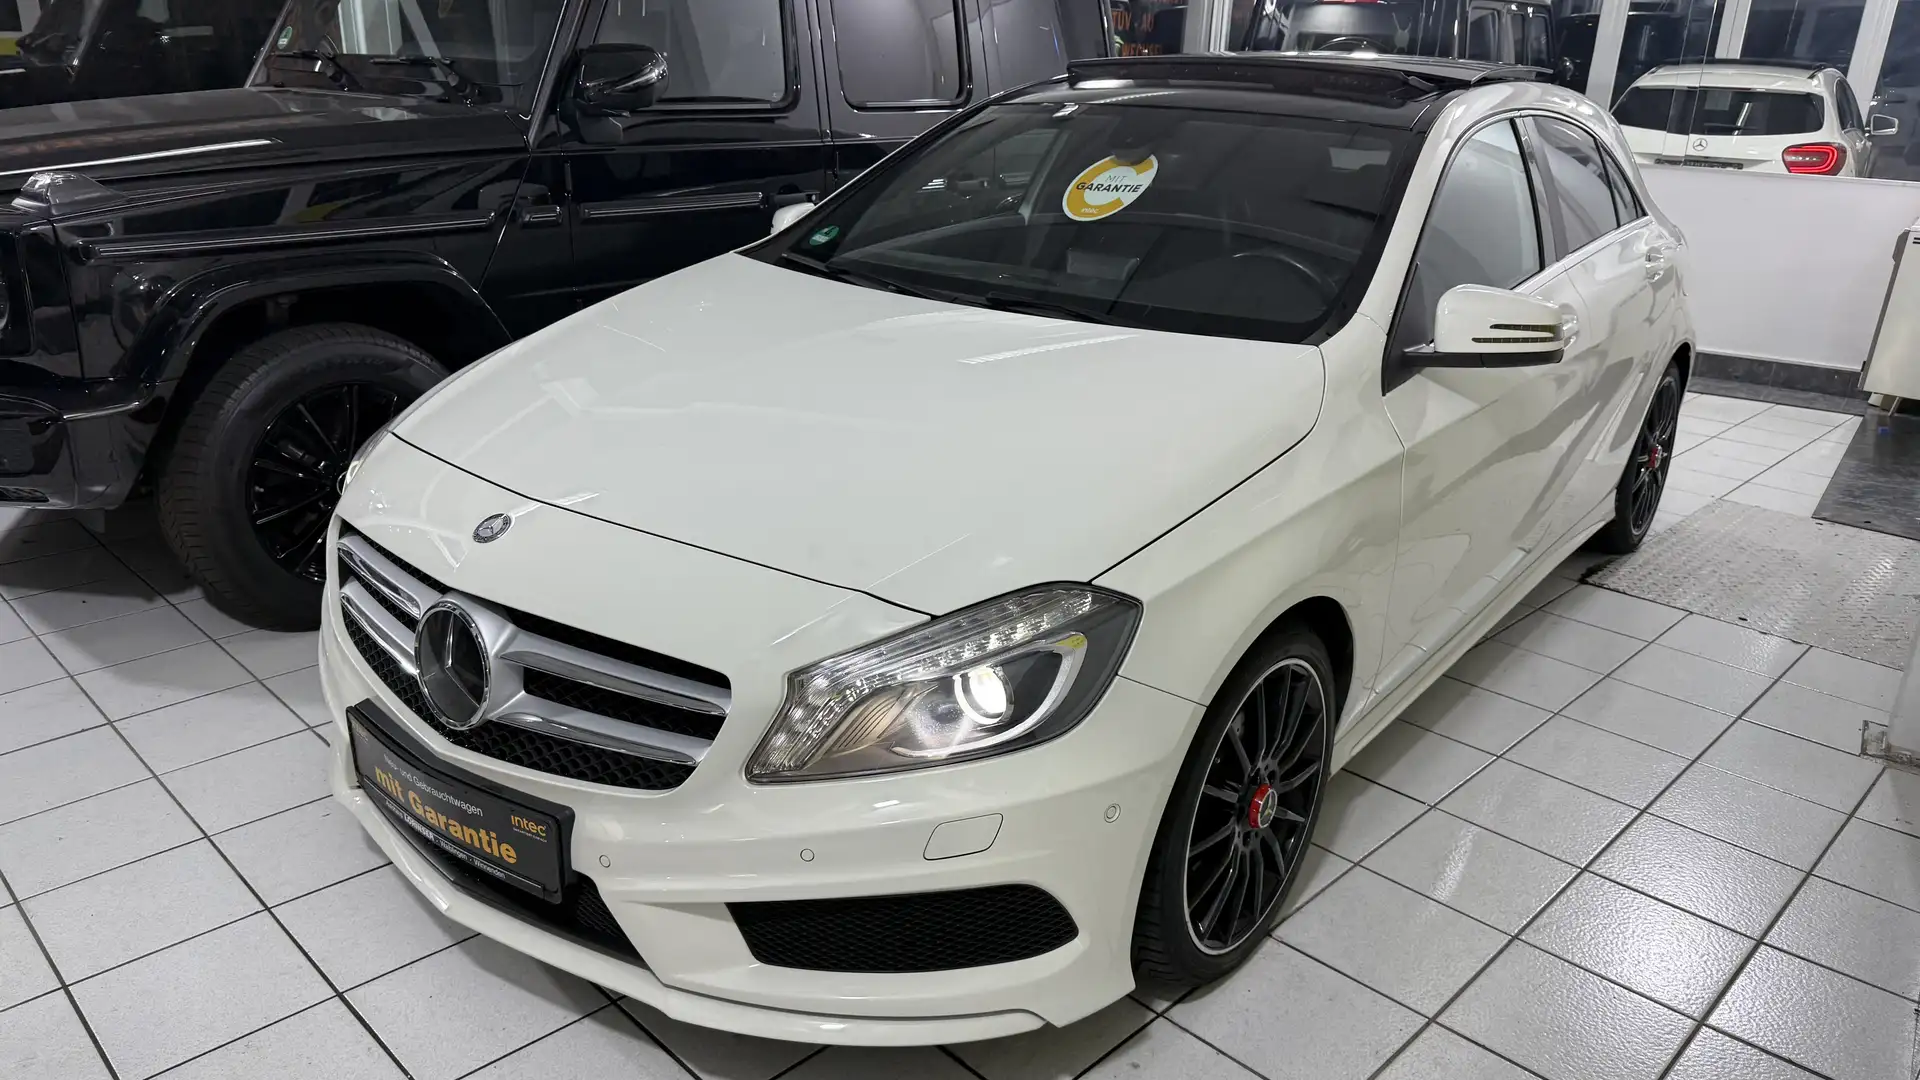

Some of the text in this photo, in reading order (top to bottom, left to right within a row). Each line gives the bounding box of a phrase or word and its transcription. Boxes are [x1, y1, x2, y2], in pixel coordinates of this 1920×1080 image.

[1075, 182, 1144, 193] GARANTIE
[1105, 174, 1129, 183] MIT
[400, 768, 413, 782] und
[413, 775, 484, 817] Gebrauchtwagen
[374, 765, 518, 864] mit Garantie
[510, 814, 547, 837] intec
